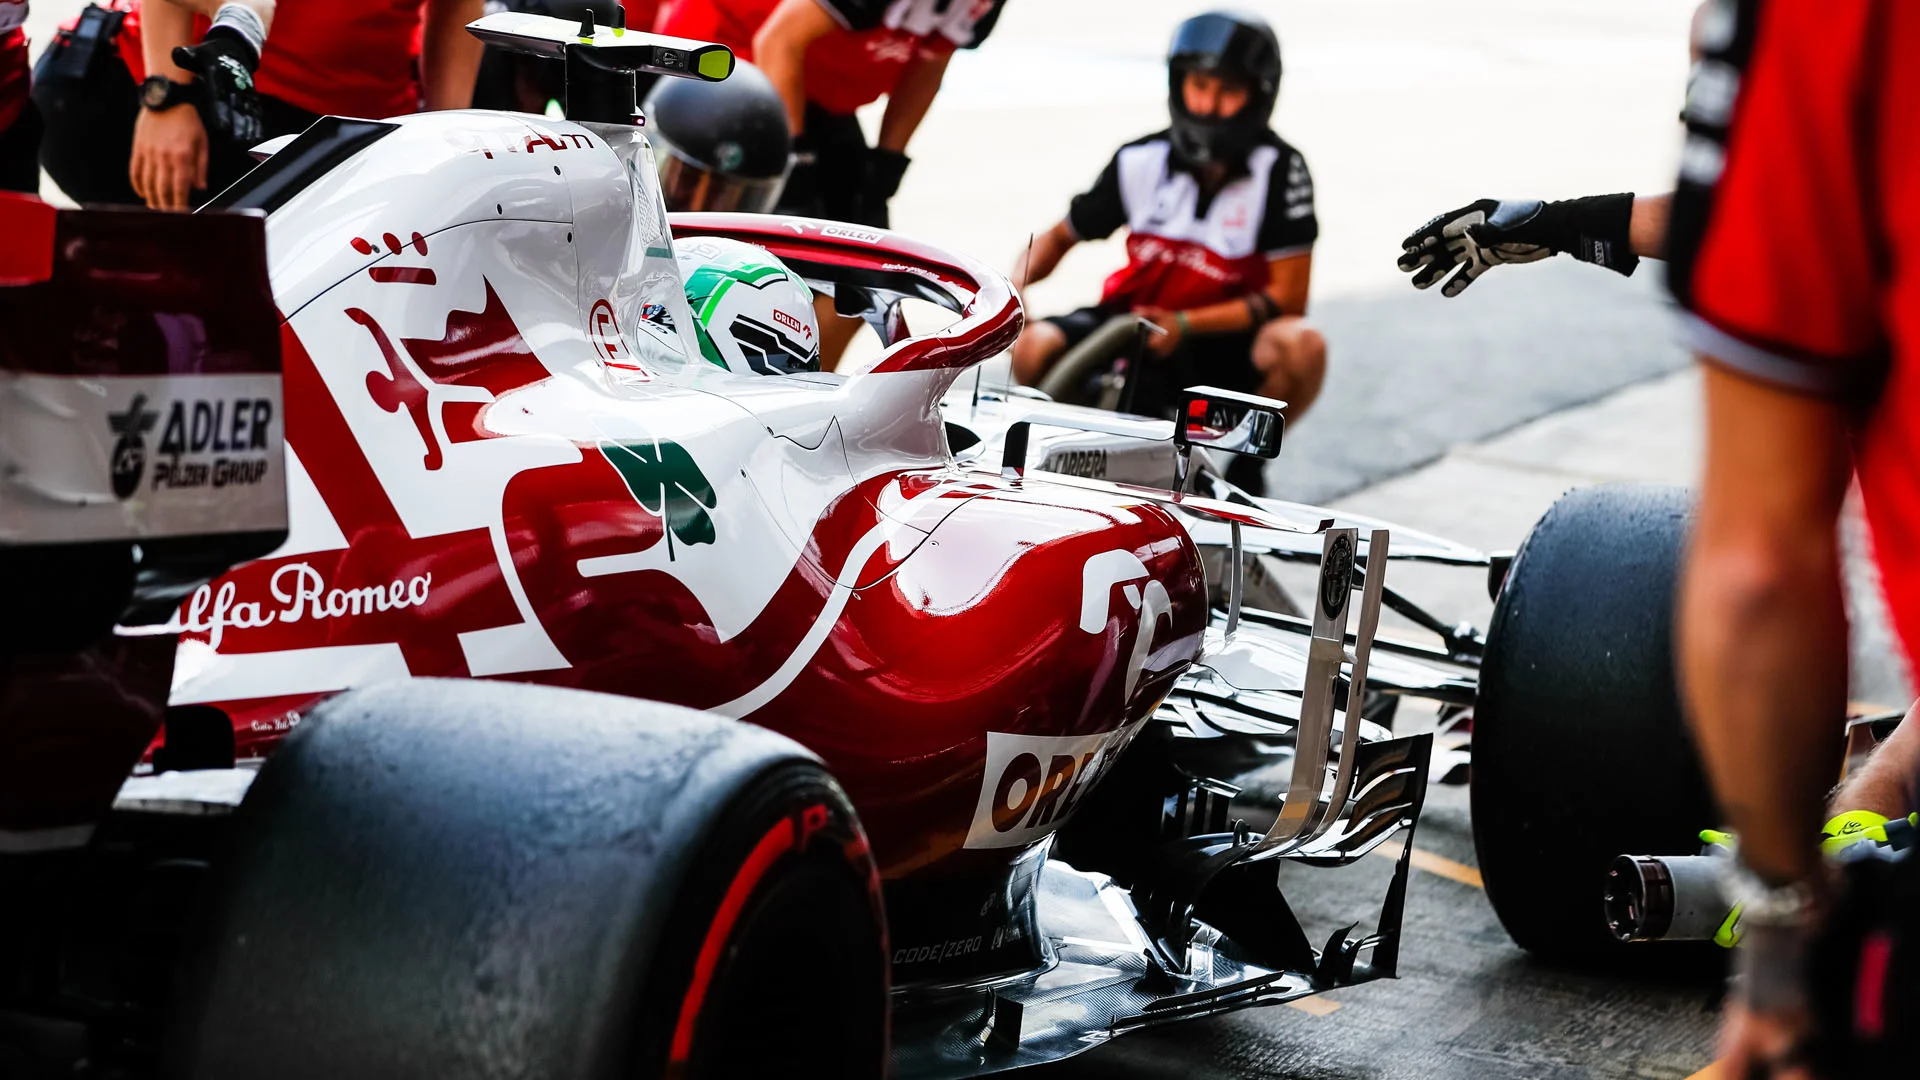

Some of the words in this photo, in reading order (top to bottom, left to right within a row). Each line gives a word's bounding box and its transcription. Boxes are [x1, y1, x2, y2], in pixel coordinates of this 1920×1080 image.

[775, 311, 800, 331] ORLEN
[158, 399, 272, 454] ADLER
[212, 457, 268, 487] GROUP
[270, 562, 431, 623] Romeo
[893, 935, 982, 964] CODE/ZERO
